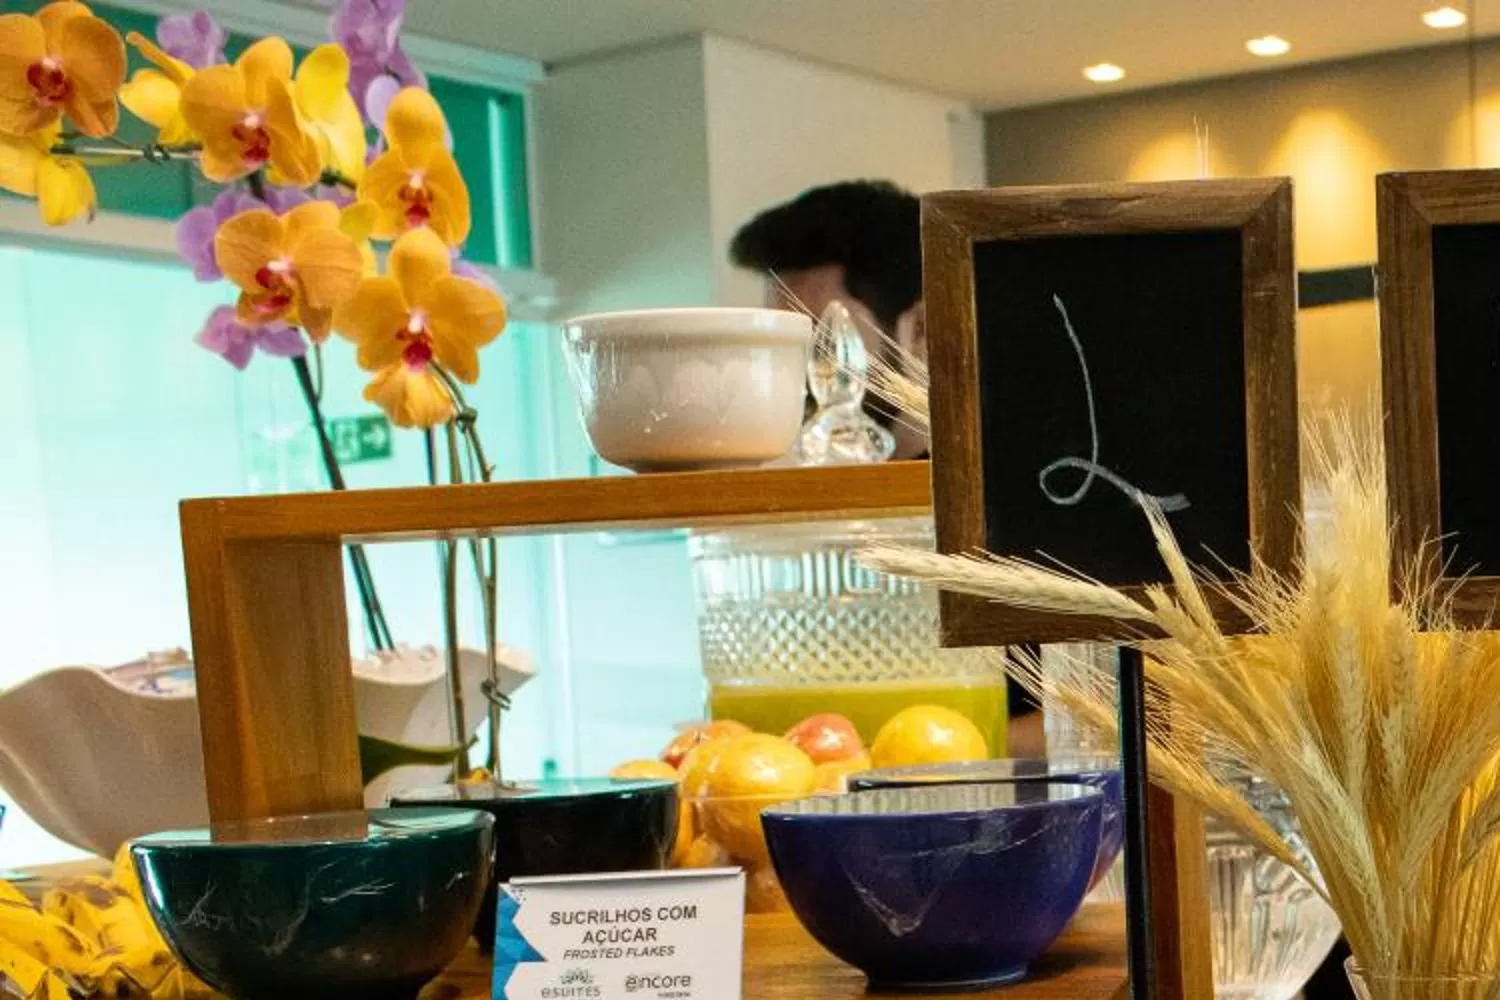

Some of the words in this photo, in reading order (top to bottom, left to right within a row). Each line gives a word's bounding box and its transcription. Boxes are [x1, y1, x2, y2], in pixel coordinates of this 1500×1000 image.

[549, 908, 652, 926] SUCRILHOS
[657, 905, 697, 921] COM
[582, 926, 657, 944] AÇÚCAR
[563, 948, 623, 960] FROSTED
[626, 945, 676, 958] FLAKES
[625, 974, 692, 992] encore
